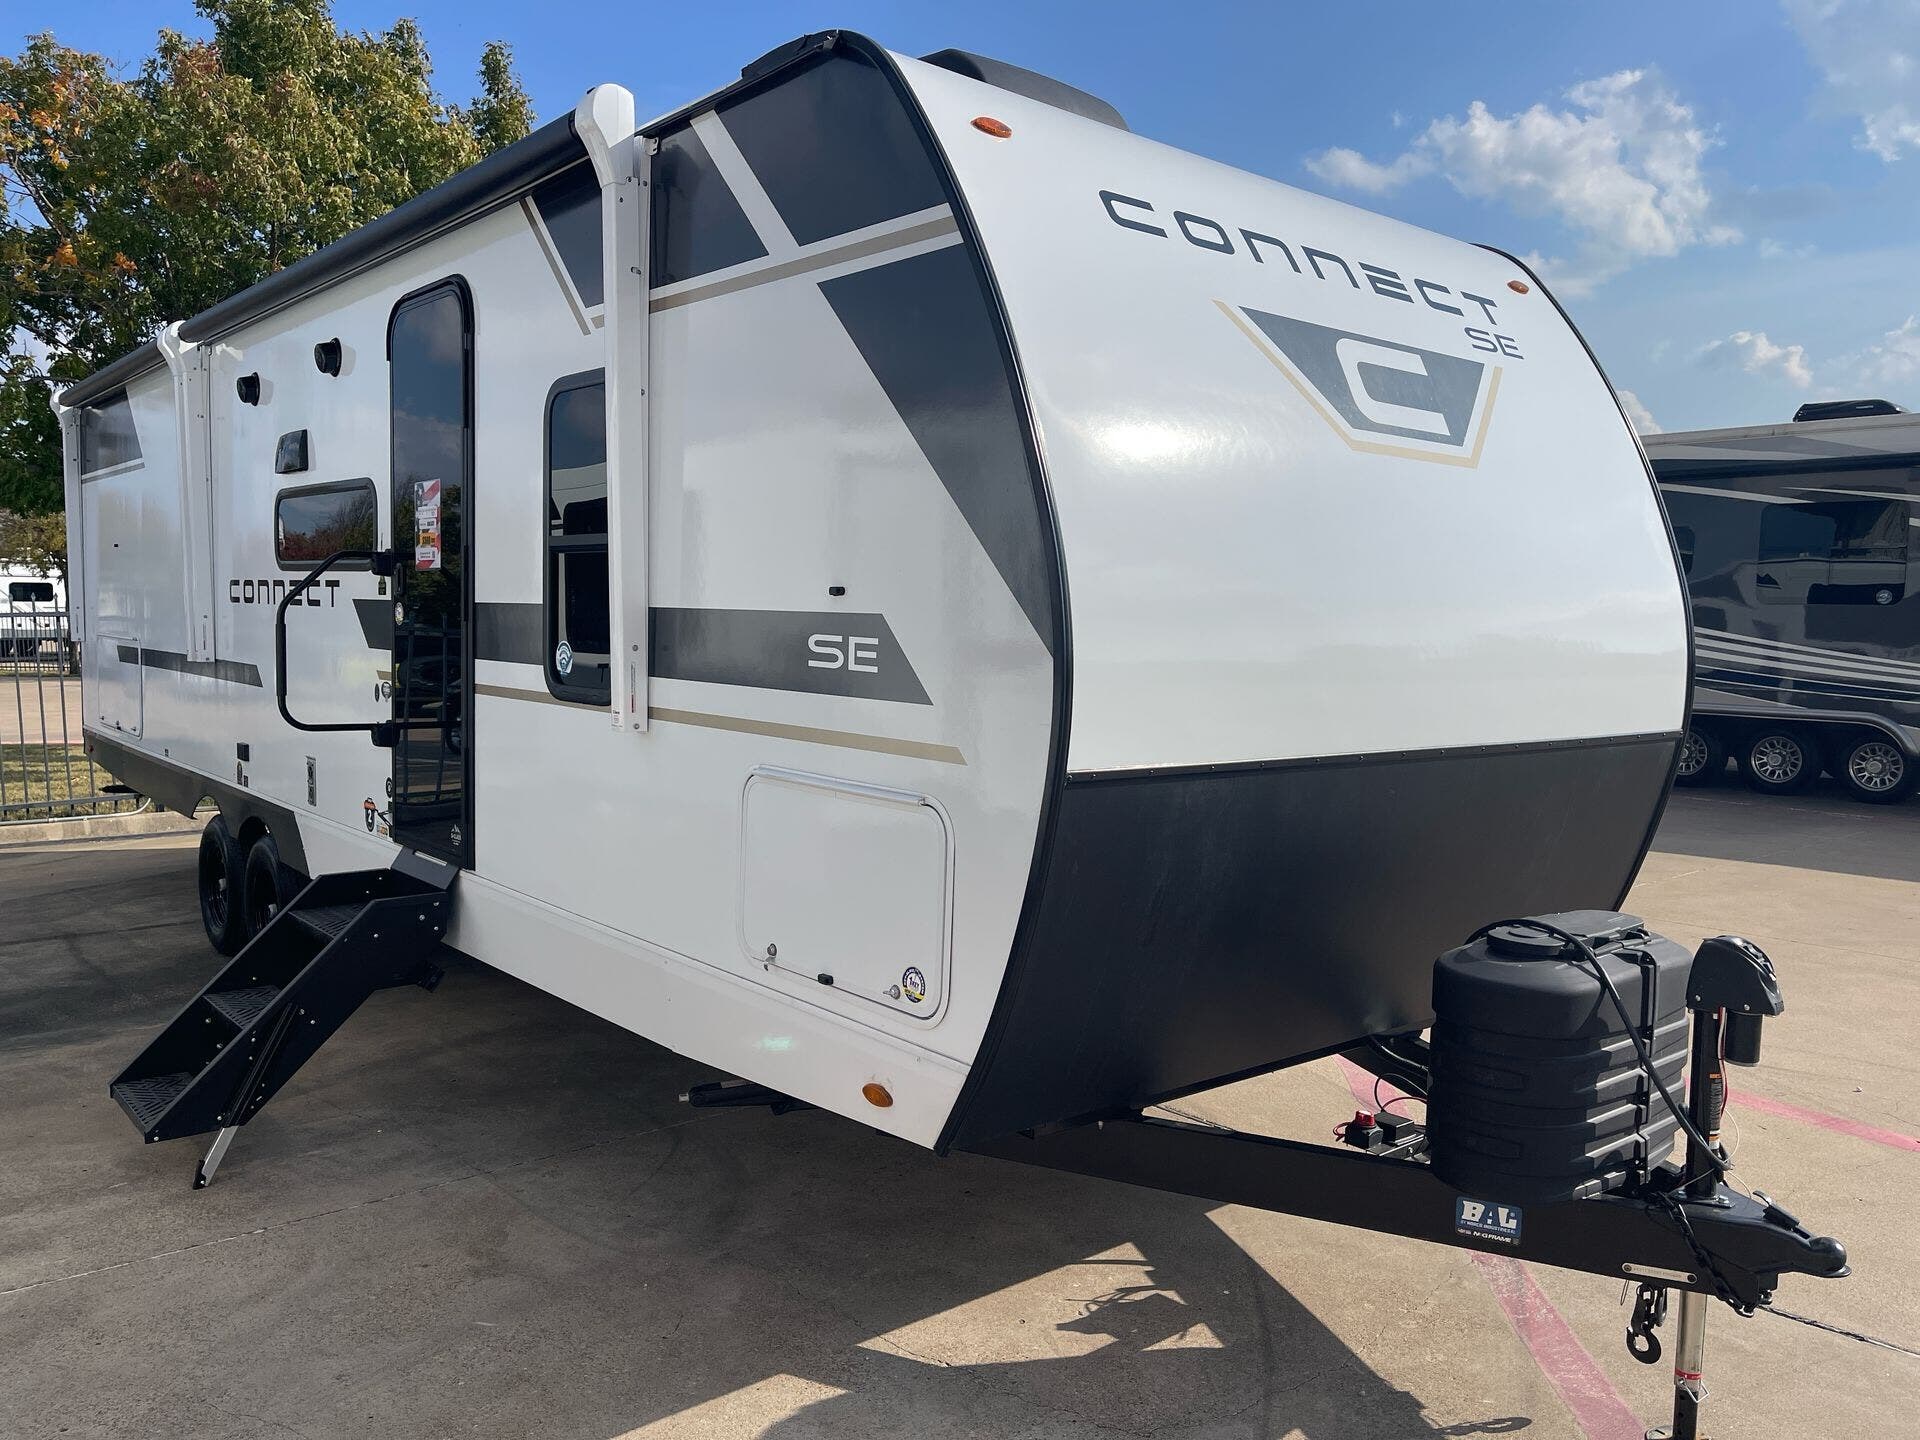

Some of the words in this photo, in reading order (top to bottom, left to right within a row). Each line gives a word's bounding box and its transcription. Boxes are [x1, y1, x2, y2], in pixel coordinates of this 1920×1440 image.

[1463, 326, 1525, 360] SE
[807, 633, 879, 674] SE
[1461, 1200, 1517, 1229] BAL
